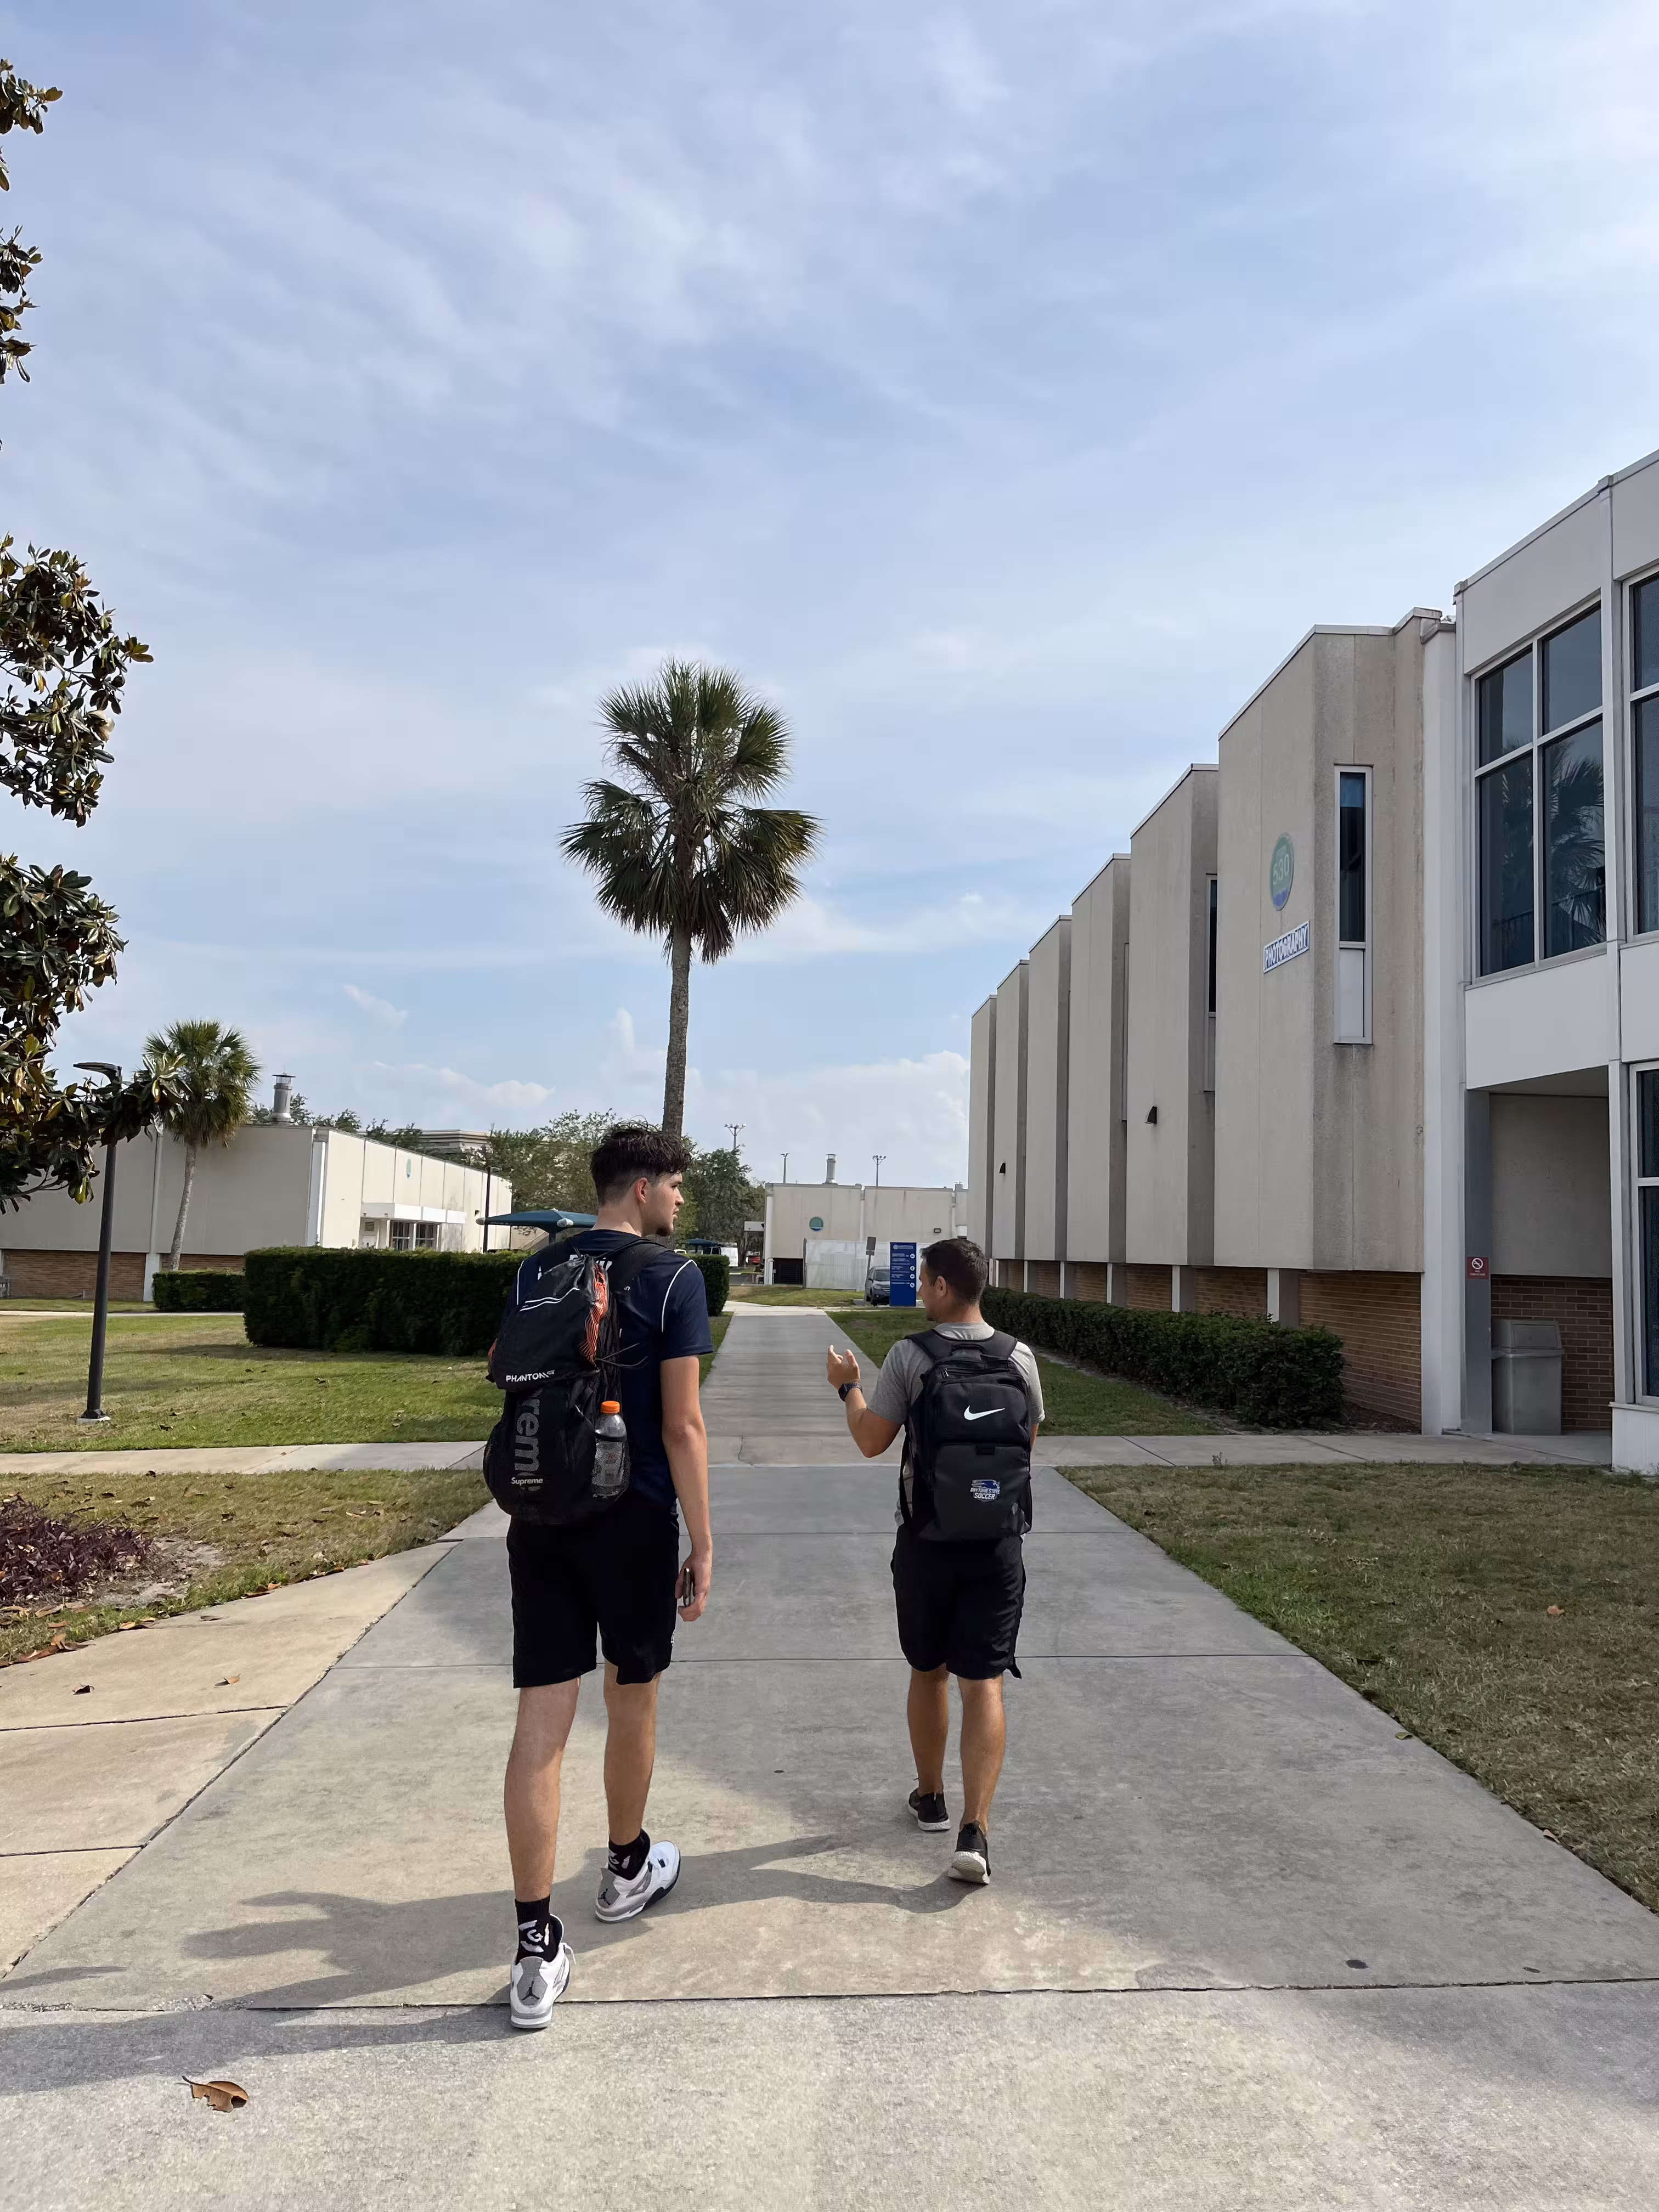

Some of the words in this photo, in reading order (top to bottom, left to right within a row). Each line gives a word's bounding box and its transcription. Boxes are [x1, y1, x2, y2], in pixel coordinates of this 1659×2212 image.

[1273, 853, 1290, 885] 530
[1265, 924, 1308, 968] PHOTOGRAPHY
[506, 1372, 549, 1382] PHANTOM
[511, 1477, 543, 1486] Supreme
